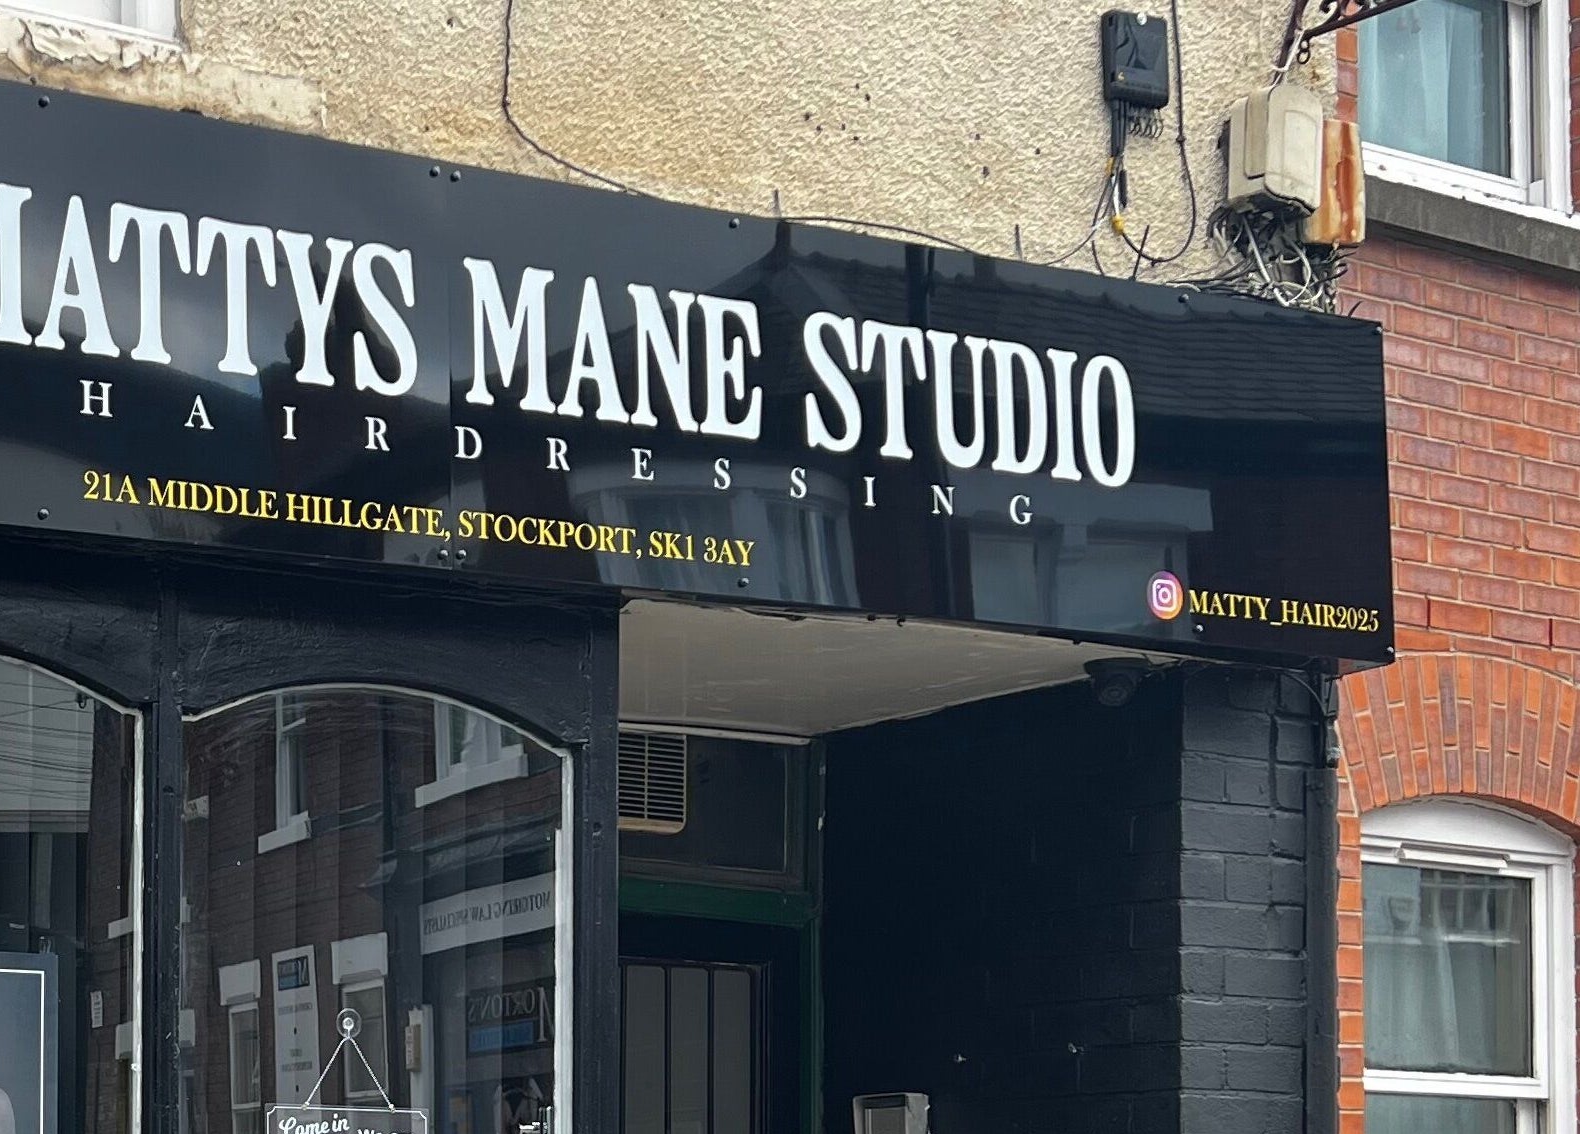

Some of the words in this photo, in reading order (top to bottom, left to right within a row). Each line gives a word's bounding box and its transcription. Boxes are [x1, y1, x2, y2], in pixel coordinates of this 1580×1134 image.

[462, 256, 763, 440] MANE
[803, 310, 1137, 488] STUDIO
[78, 378, 1034, 526] HAIRDRESSING
[82, 470, 140, 505] 21A
[147, 477, 279, 520] MIDDLE
[286, 492, 451, 543] HILLGATE,
[457, 509, 643, 561] STOCKPORT,
[648, 530, 695, 561] SK1
[703, 536, 756, 567] 3AY
[1188, 588, 1381, 633] MATTY_HAIR2025
[331, 1113, 350, 1133] in
